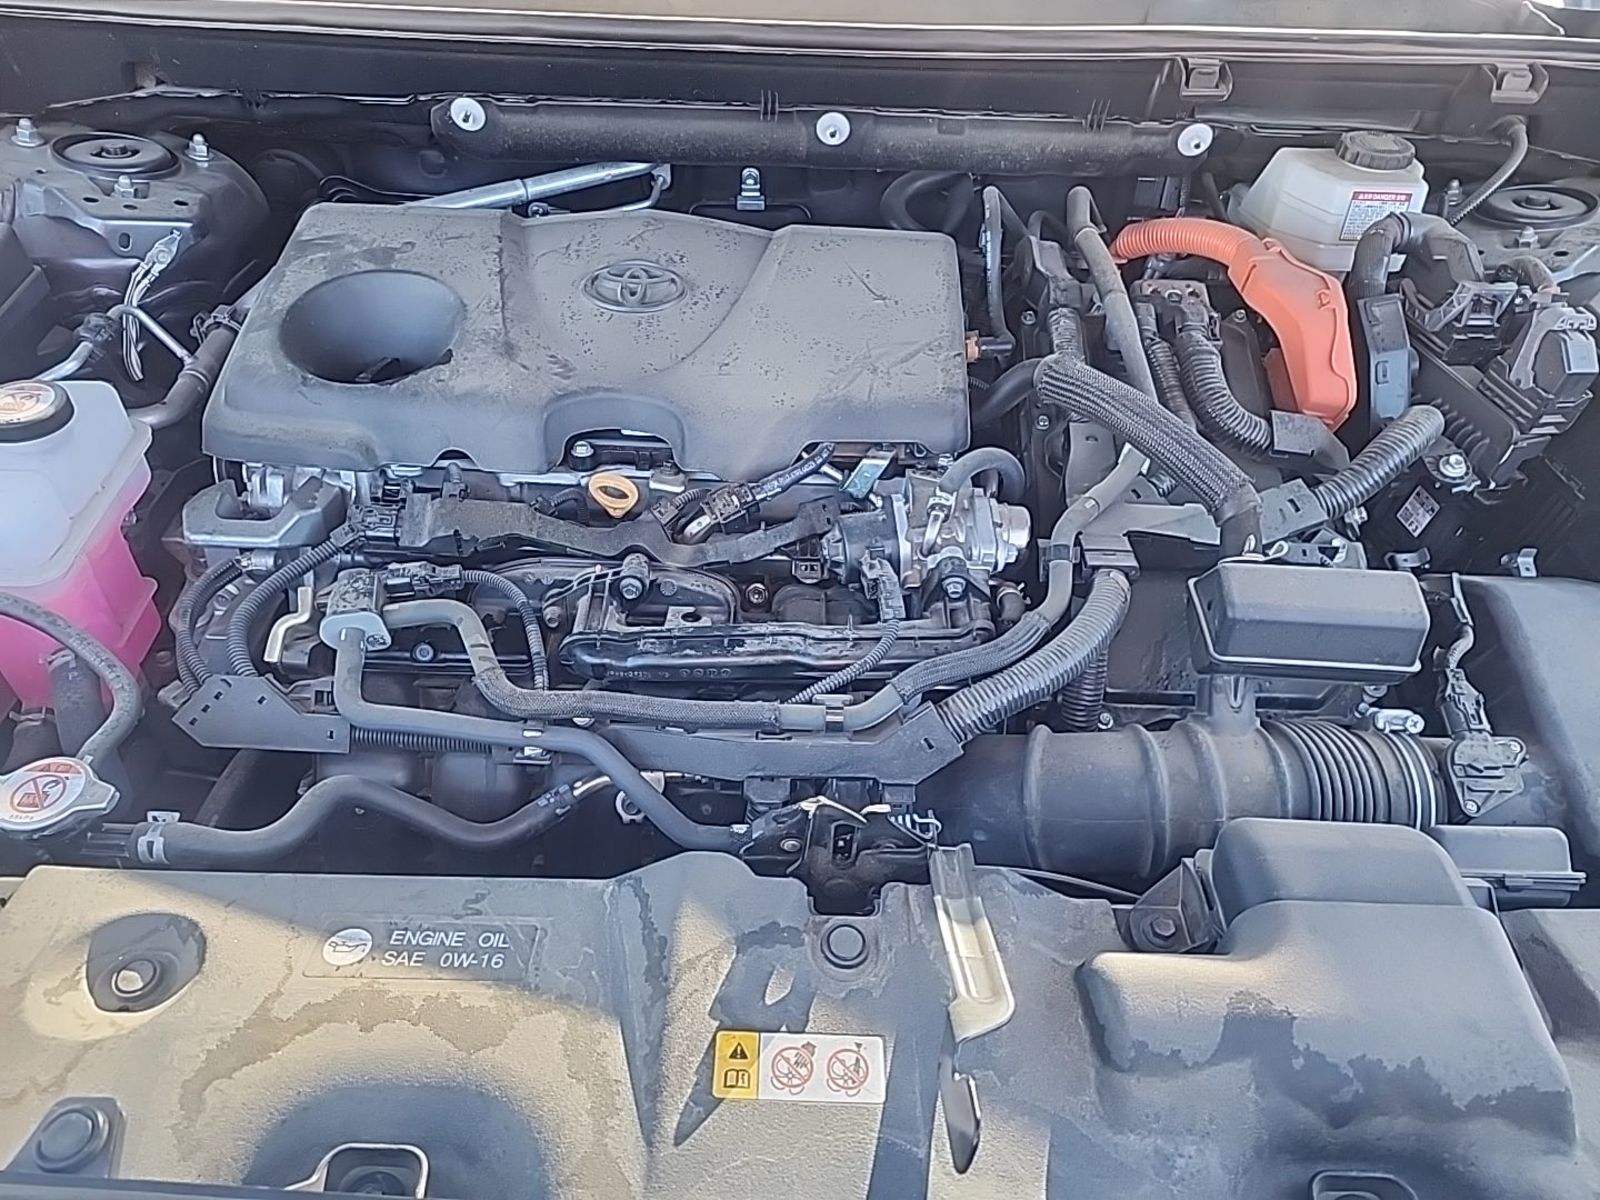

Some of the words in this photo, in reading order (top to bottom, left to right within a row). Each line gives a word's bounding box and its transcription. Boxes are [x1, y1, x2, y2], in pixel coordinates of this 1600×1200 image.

[390, 930, 467, 947] ENGINE
[478, 932, 510, 948] OIL
[381, 951, 426, 967] SAE
[439, 952, 505, 969] 0W-16
